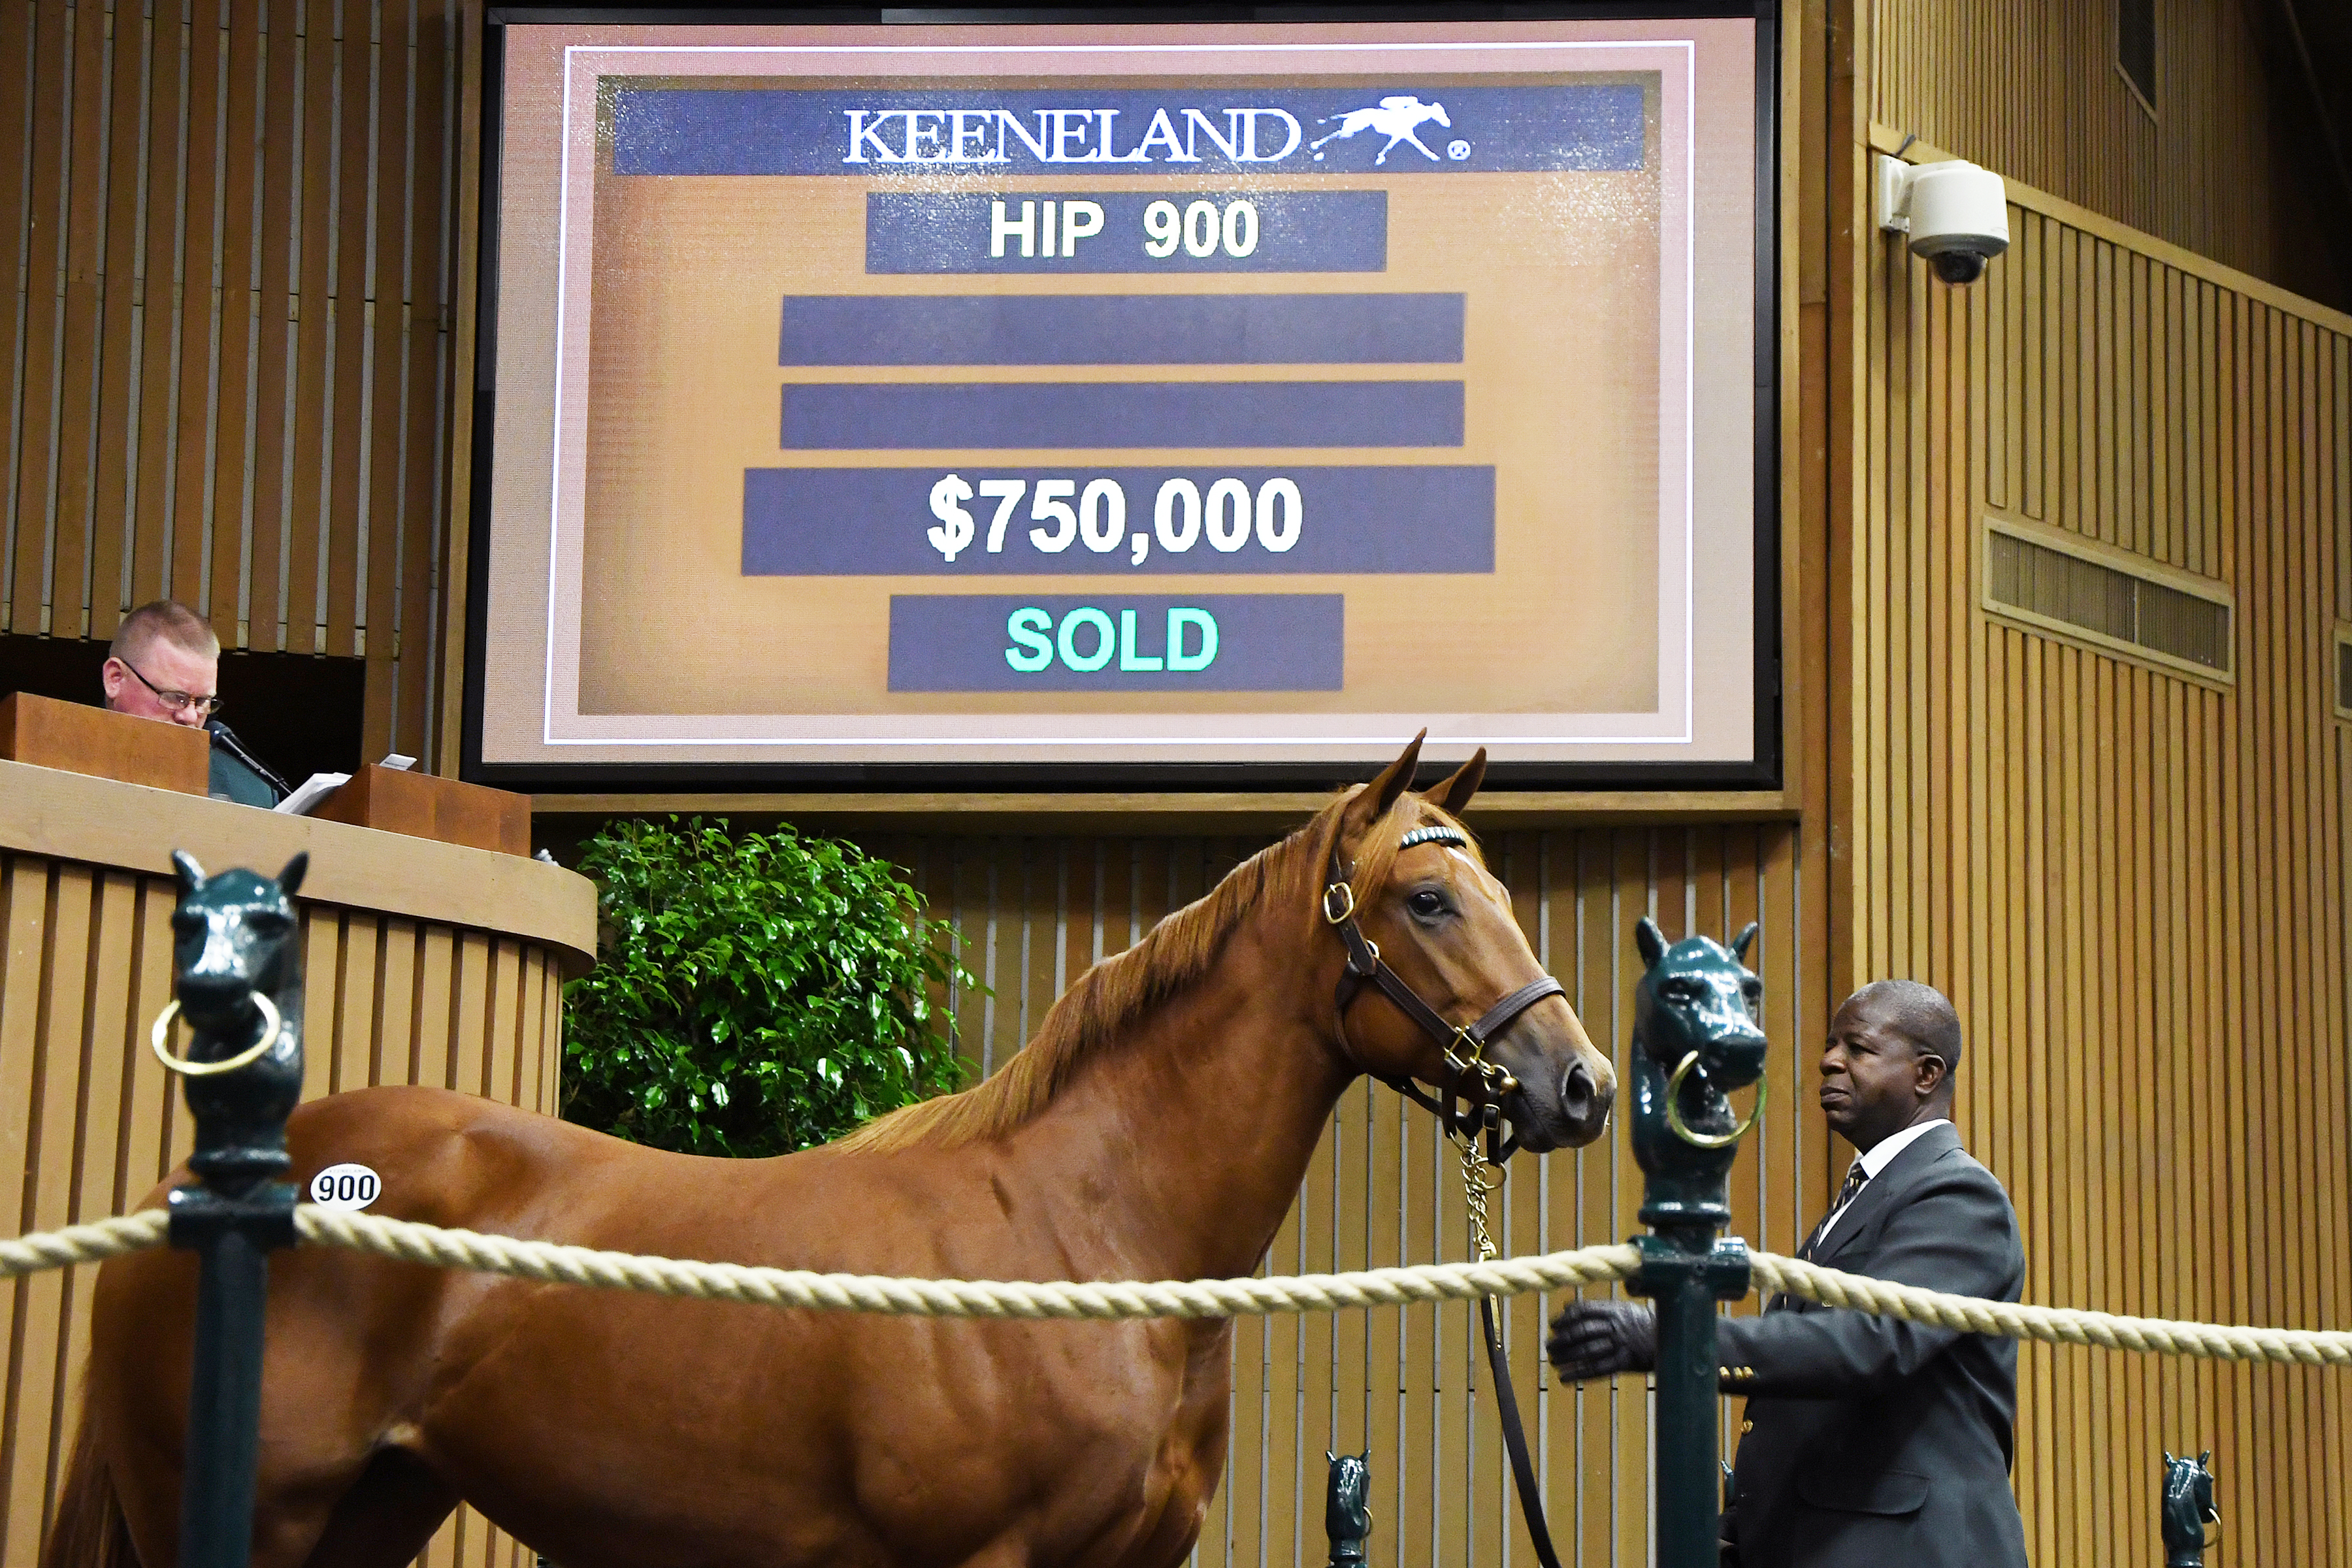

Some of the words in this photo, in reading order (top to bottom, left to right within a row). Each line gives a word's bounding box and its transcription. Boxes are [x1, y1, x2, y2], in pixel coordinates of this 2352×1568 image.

[842, 108, 1302, 165] KEENELAND
[991, 201, 1104, 257] HIP
[1144, 199, 1258, 257] 900
[928, 474, 1303, 565] $750,000
[1004, 606, 1220, 673] SOLD
[319, 1175, 374, 1201] 900
